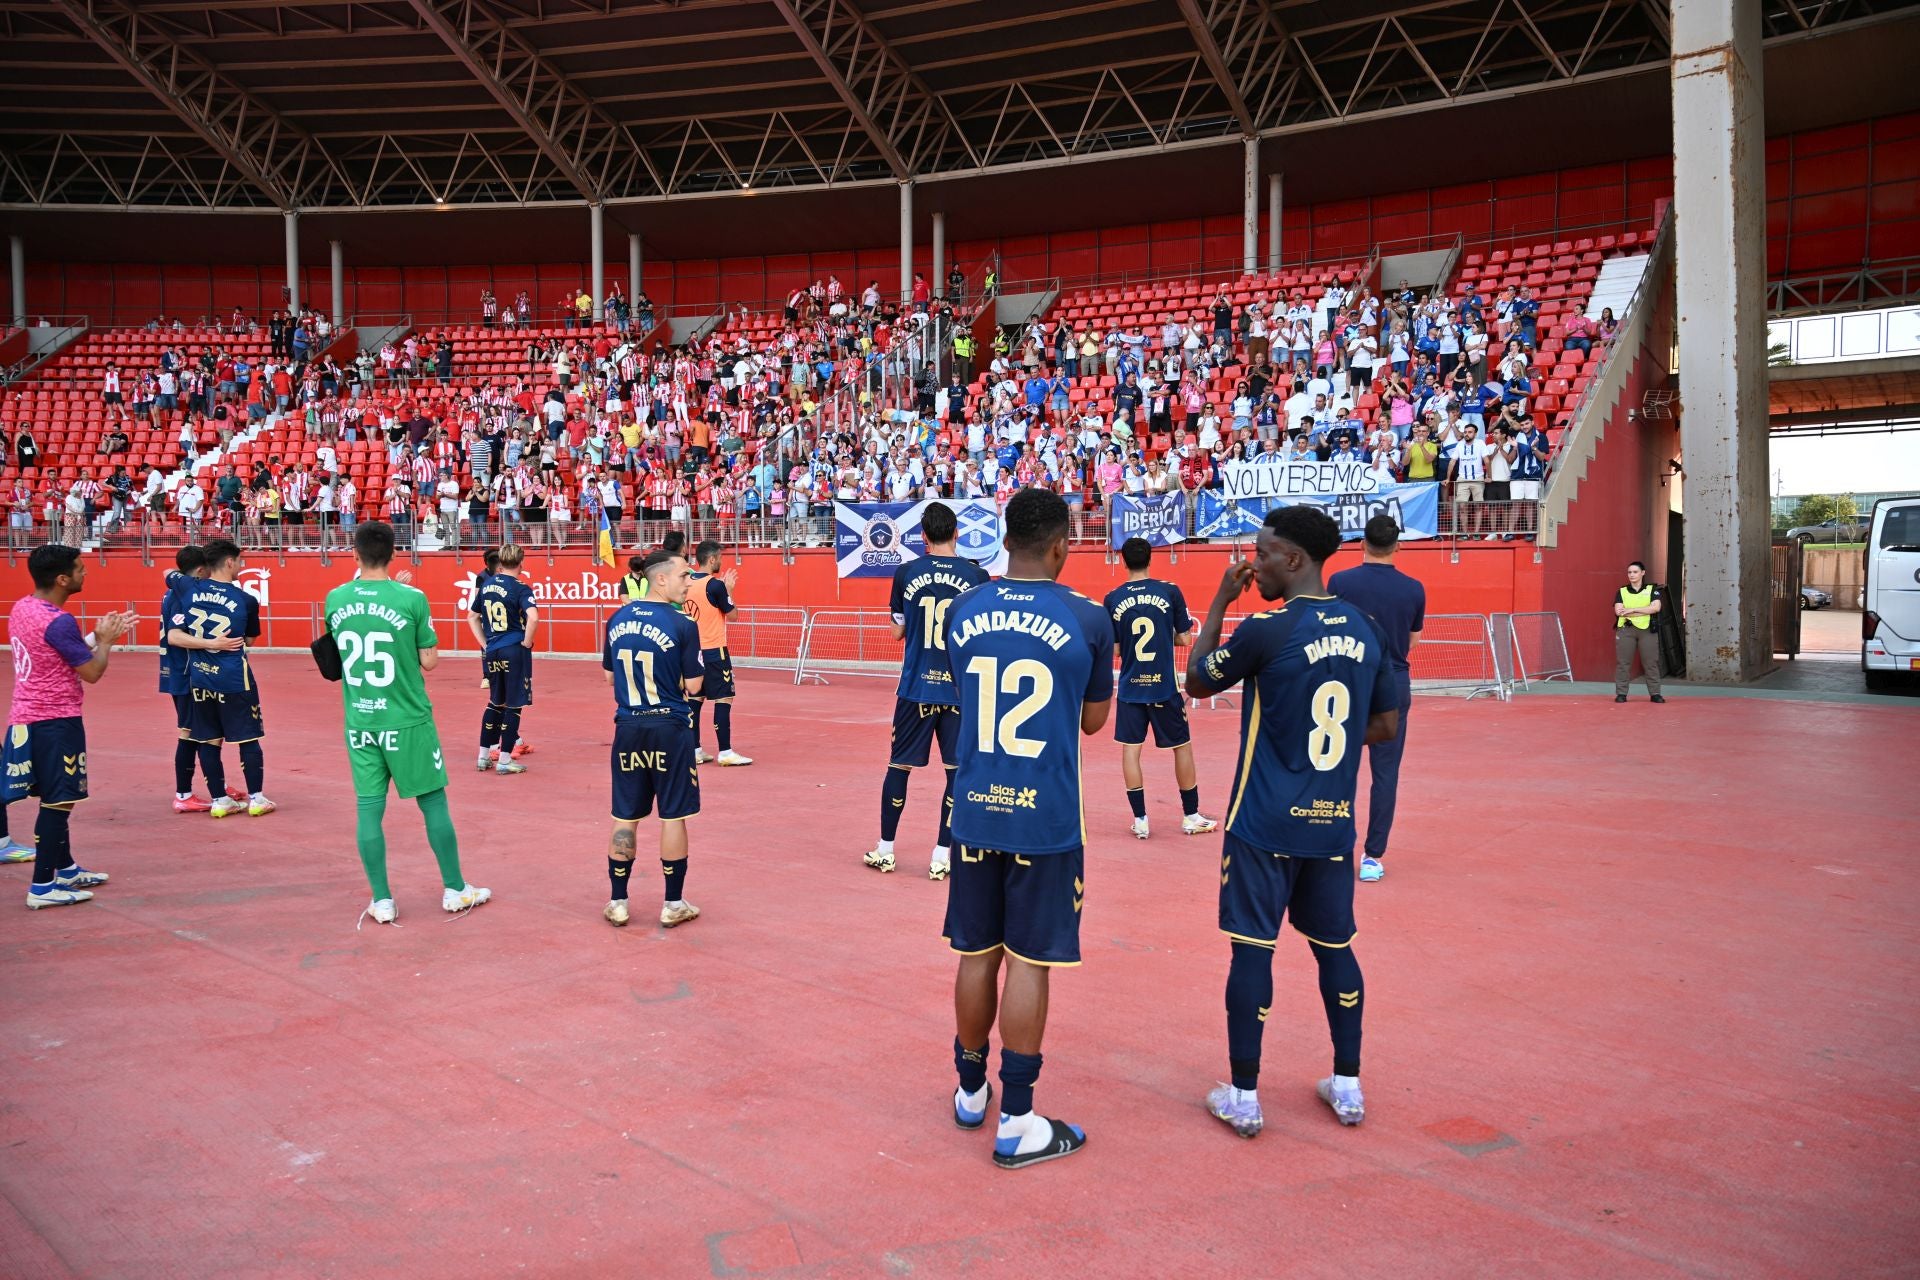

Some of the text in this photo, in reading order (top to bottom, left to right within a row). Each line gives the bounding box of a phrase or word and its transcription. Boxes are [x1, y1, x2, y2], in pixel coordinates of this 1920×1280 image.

[1224, 463, 1377, 496] VOLVEREMOS
[903, 572, 971, 601] ENRIC GALLE
[331, 602, 408, 631] EDGAR BADIA
[484, 599, 508, 633] 19
[1112, 597, 1136, 622] DAVID
[642, 624, 675, 652] CRUZ
[952, 610, 1071, 651] LANDAZURI
[1131, 616, 1157, 662] 2
[337, 630, 395, 688] 25
[1304, 635, 1366, 665] DIARRA
[617, 649, 661, 707] 11
[965, 655, 1054, 759] 12
[348, 730, 400, 751] EAVE
[1308, 680, 1350, 772] 8
[618, 750, 668, 772] EAVE
[967, 791, 1015, 806] Canarias
[990, 784, 1016, 797] Islas
[1312, 799, 1335, 810] Islas
[1290, 806, 1334, 817] Canarias
